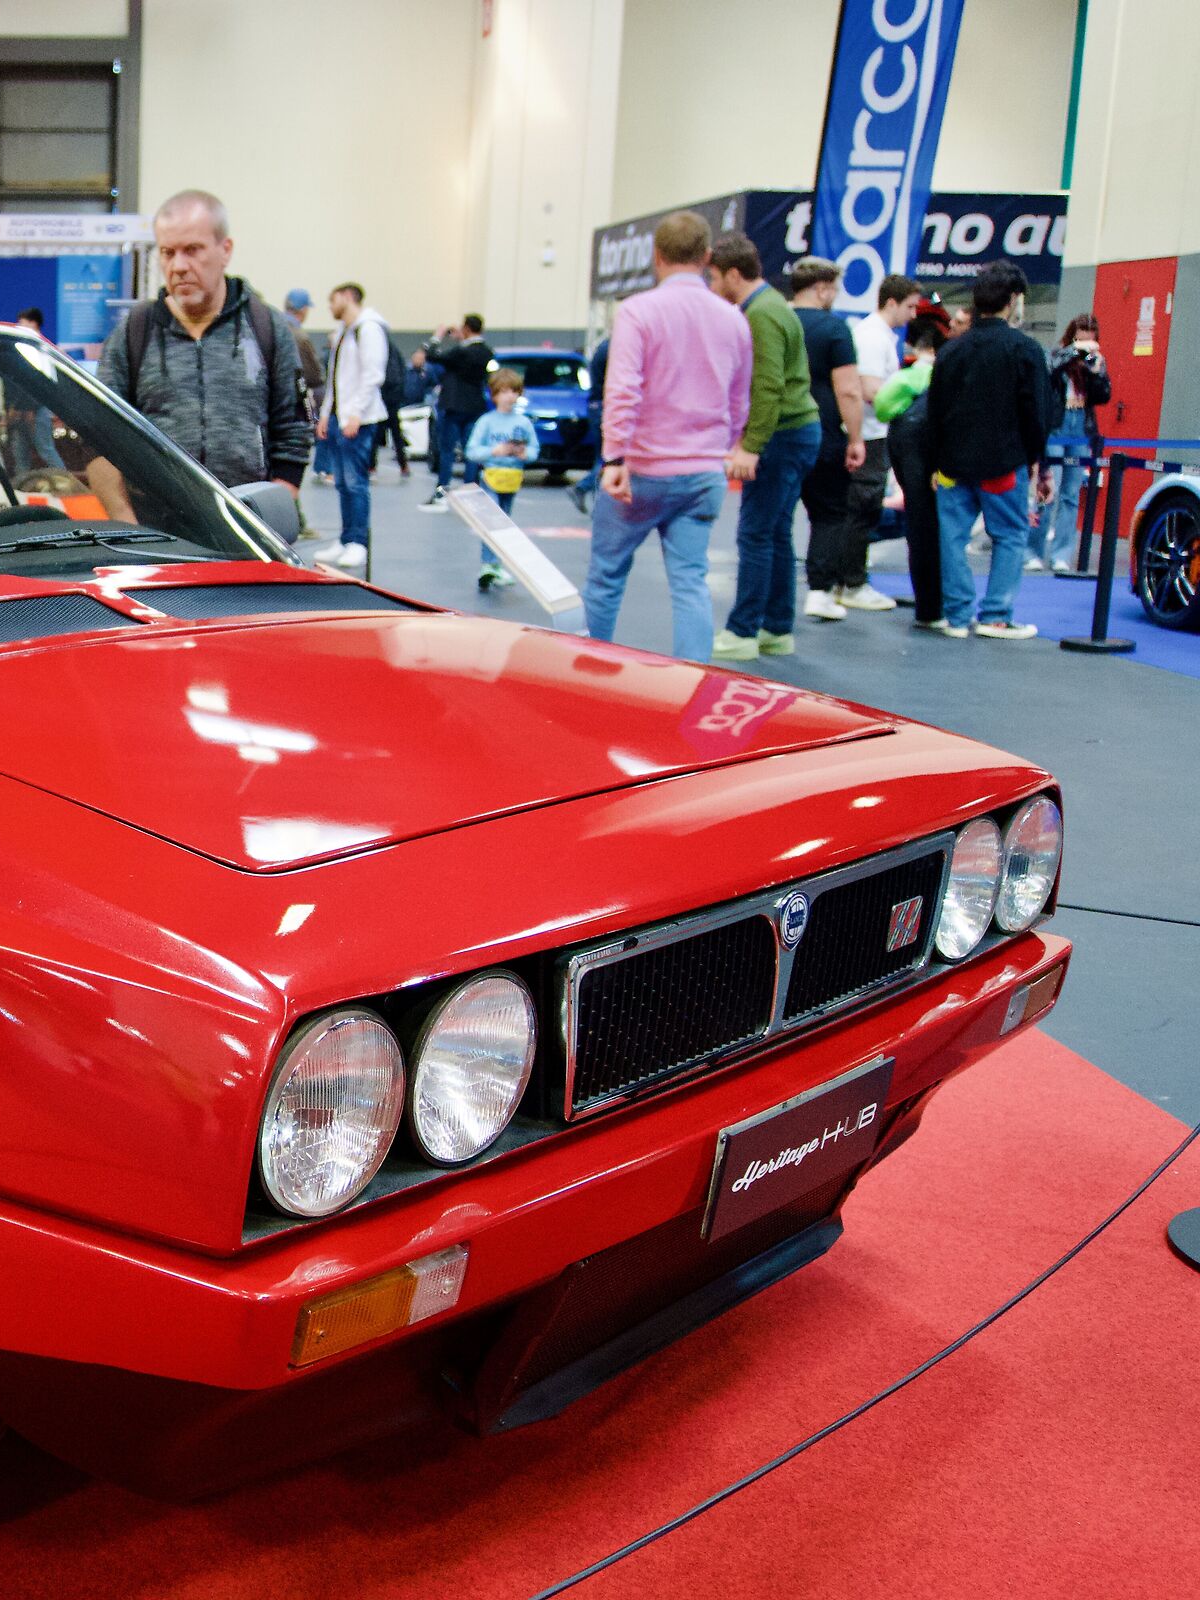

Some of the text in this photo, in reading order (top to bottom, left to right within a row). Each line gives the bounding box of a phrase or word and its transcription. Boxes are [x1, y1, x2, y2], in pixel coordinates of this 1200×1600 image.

[830, 0, 932, 313] parco
[731, 1102, 877, 1193] Heritage HUB
